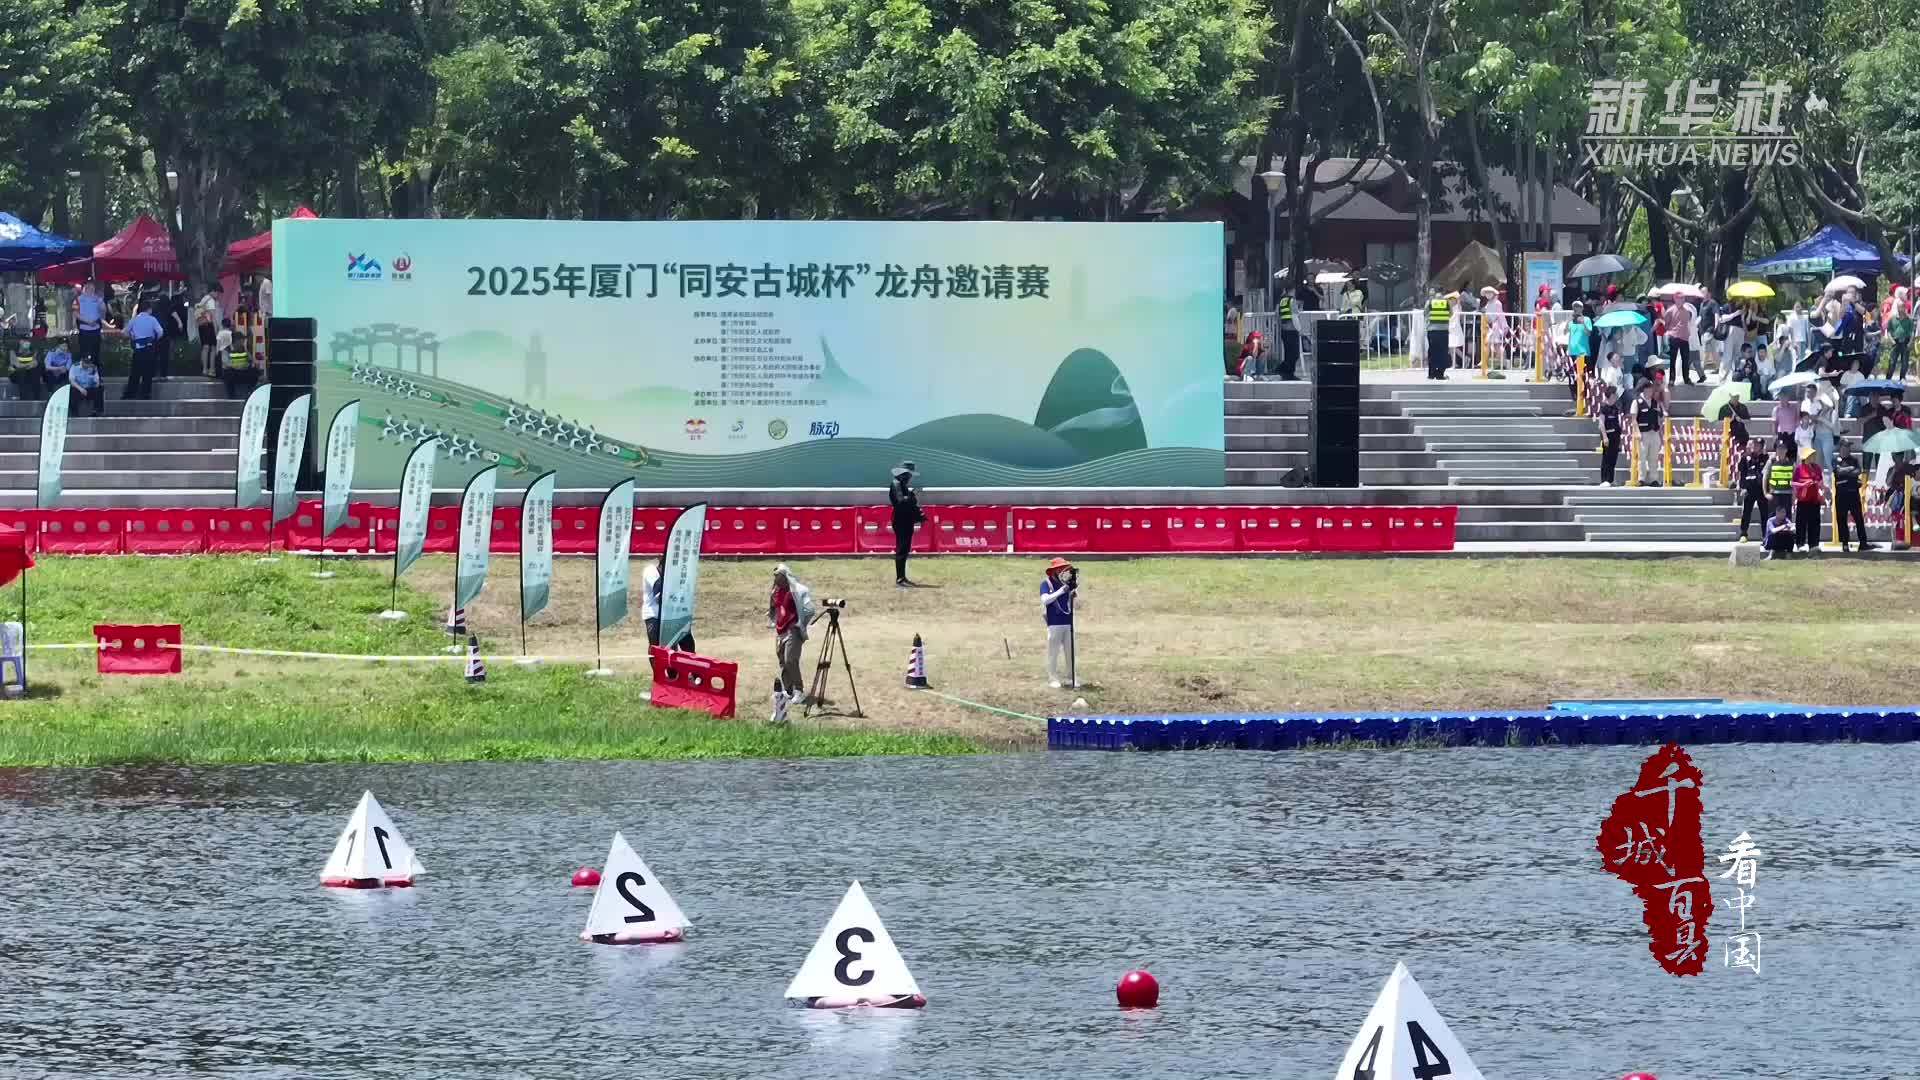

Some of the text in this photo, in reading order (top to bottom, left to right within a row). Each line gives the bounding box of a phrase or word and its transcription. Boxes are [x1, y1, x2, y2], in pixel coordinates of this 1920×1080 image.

[467, 262, 1051, 299] 2025年厦门“同安古城杯”龙舟邀请赛
[809, 421, 839, 439] 脉动
